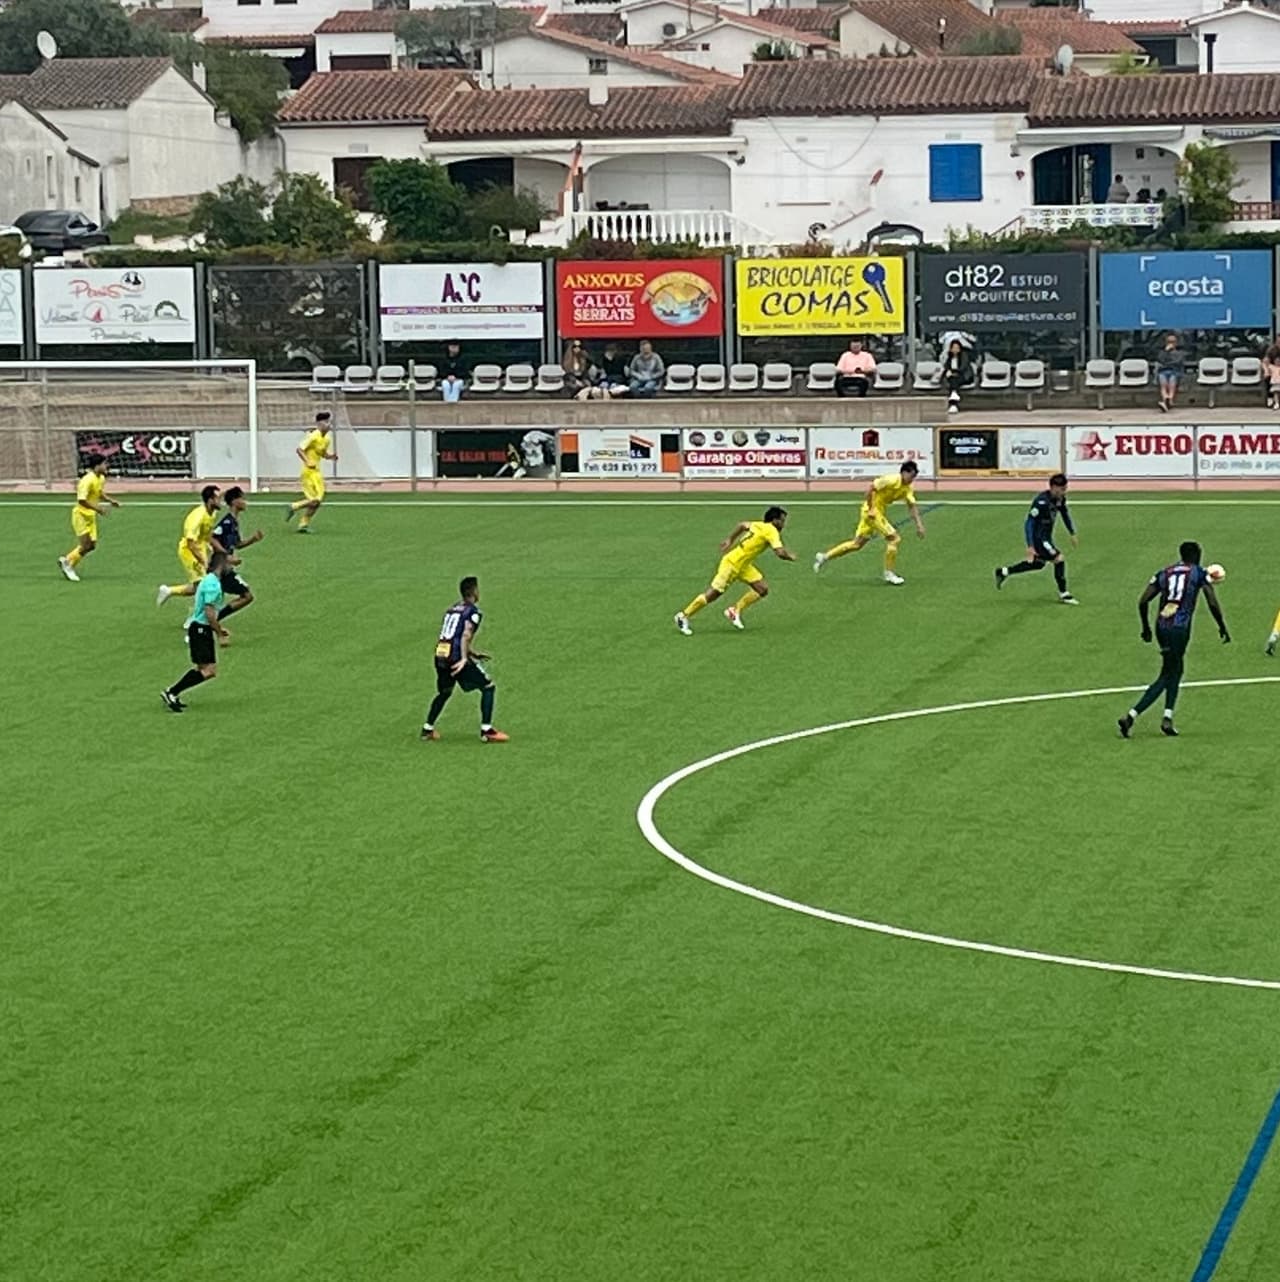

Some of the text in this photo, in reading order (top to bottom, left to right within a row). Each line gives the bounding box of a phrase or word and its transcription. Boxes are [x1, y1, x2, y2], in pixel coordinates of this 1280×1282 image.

[563, 273, 645, 289] ANXOVES
[747, 264, 855, 290] BRICOLATGE
[1011, 275, 1059, 287] ESTUDI
[1148, 275, 1223, 296] ecosta
[573, 294, 634, 307] CALLOL
[760, 290, 870, 317] COMAS
[573, 309, 635, 322] SERRATS
[1114, 434, 1193, 455] EURO
[687, 452, 743, 465] Garatge
[1167, 573, 1186, 601] 11
[439, 612, 461, 641] 10
